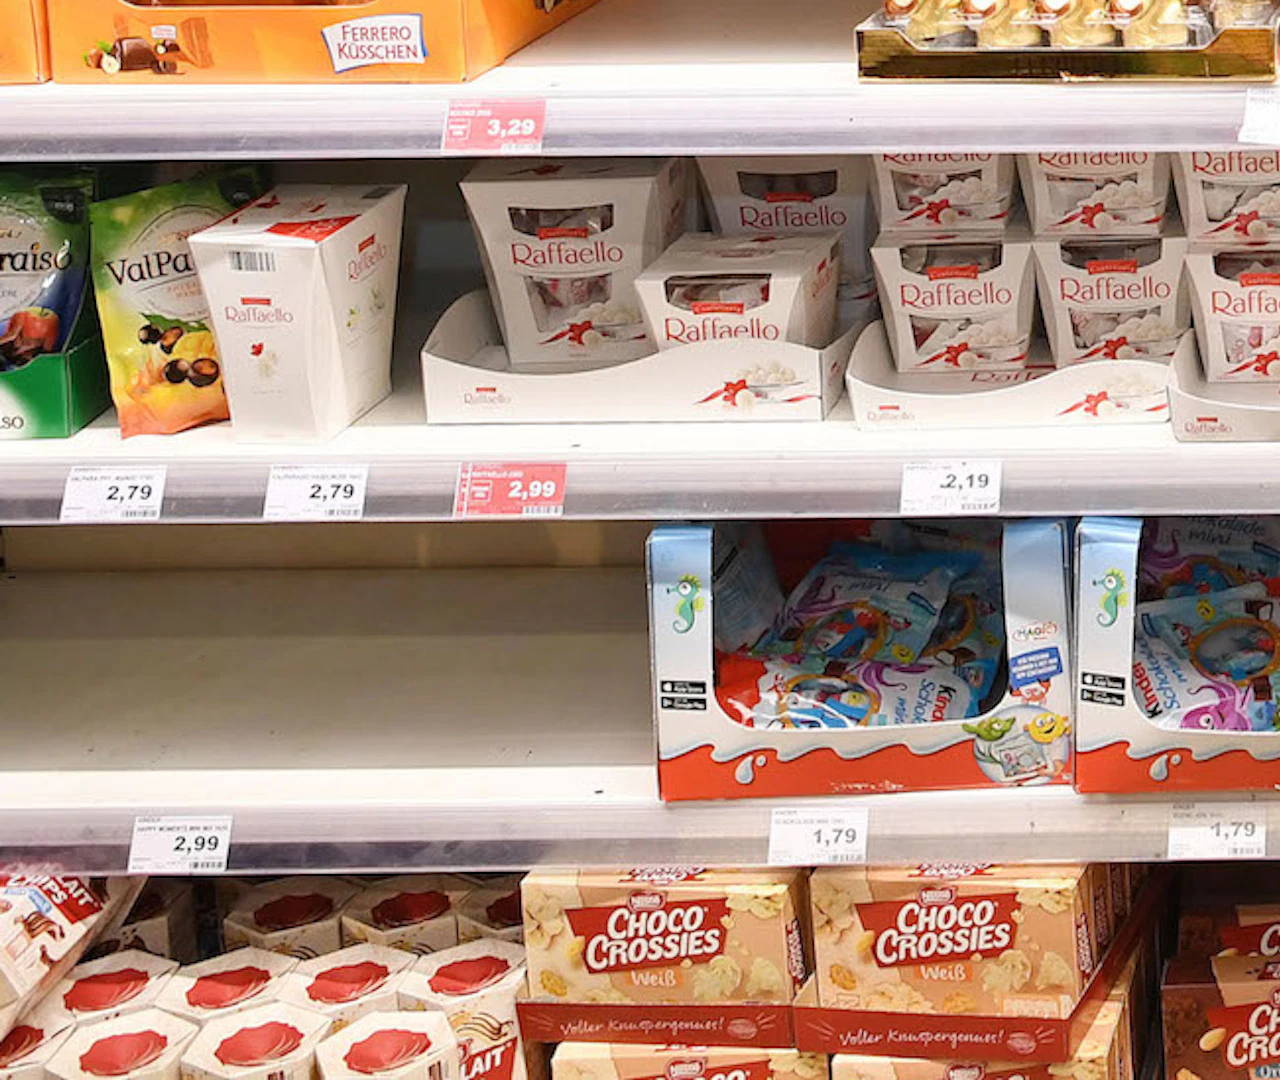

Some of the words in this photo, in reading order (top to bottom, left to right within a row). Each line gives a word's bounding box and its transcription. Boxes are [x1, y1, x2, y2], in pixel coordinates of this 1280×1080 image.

[341, 24, 413, 42] FERRERO
[487, 118, 536, 138] 3,29
[739, 205, 848, 229] Raffaello
[511, 241, 625, 268] Raffaello
[106, 250, 191, 287] ValPa
[900, 281, 1013, 309] Raffaello
[1059, 276, 1172, 303] Raffaello
[664, 317, 780, 343] Raffaello
[106, 484, 153, 503] 2,79
[309, 483, 355, 502] 2,79
[508, 480, 557, 500] 2,99
[1132, 661, 1163, 718] Kinder
[813, 827, 858, 846] 1,79
[1209, 821, 1256, 840] 1,79
[173, 835, 220, 854] 2,99
[606, 905, 705, 940] CHOCO
[897, 899, 996, 934] CHOCO
[585, 929, 721, 972] CROSSIES
[875, 923, 1011, 965] CROSSIES
[630, 969, 677, 988] Weiß
[460, 1043, 507, 1080] LAIT
